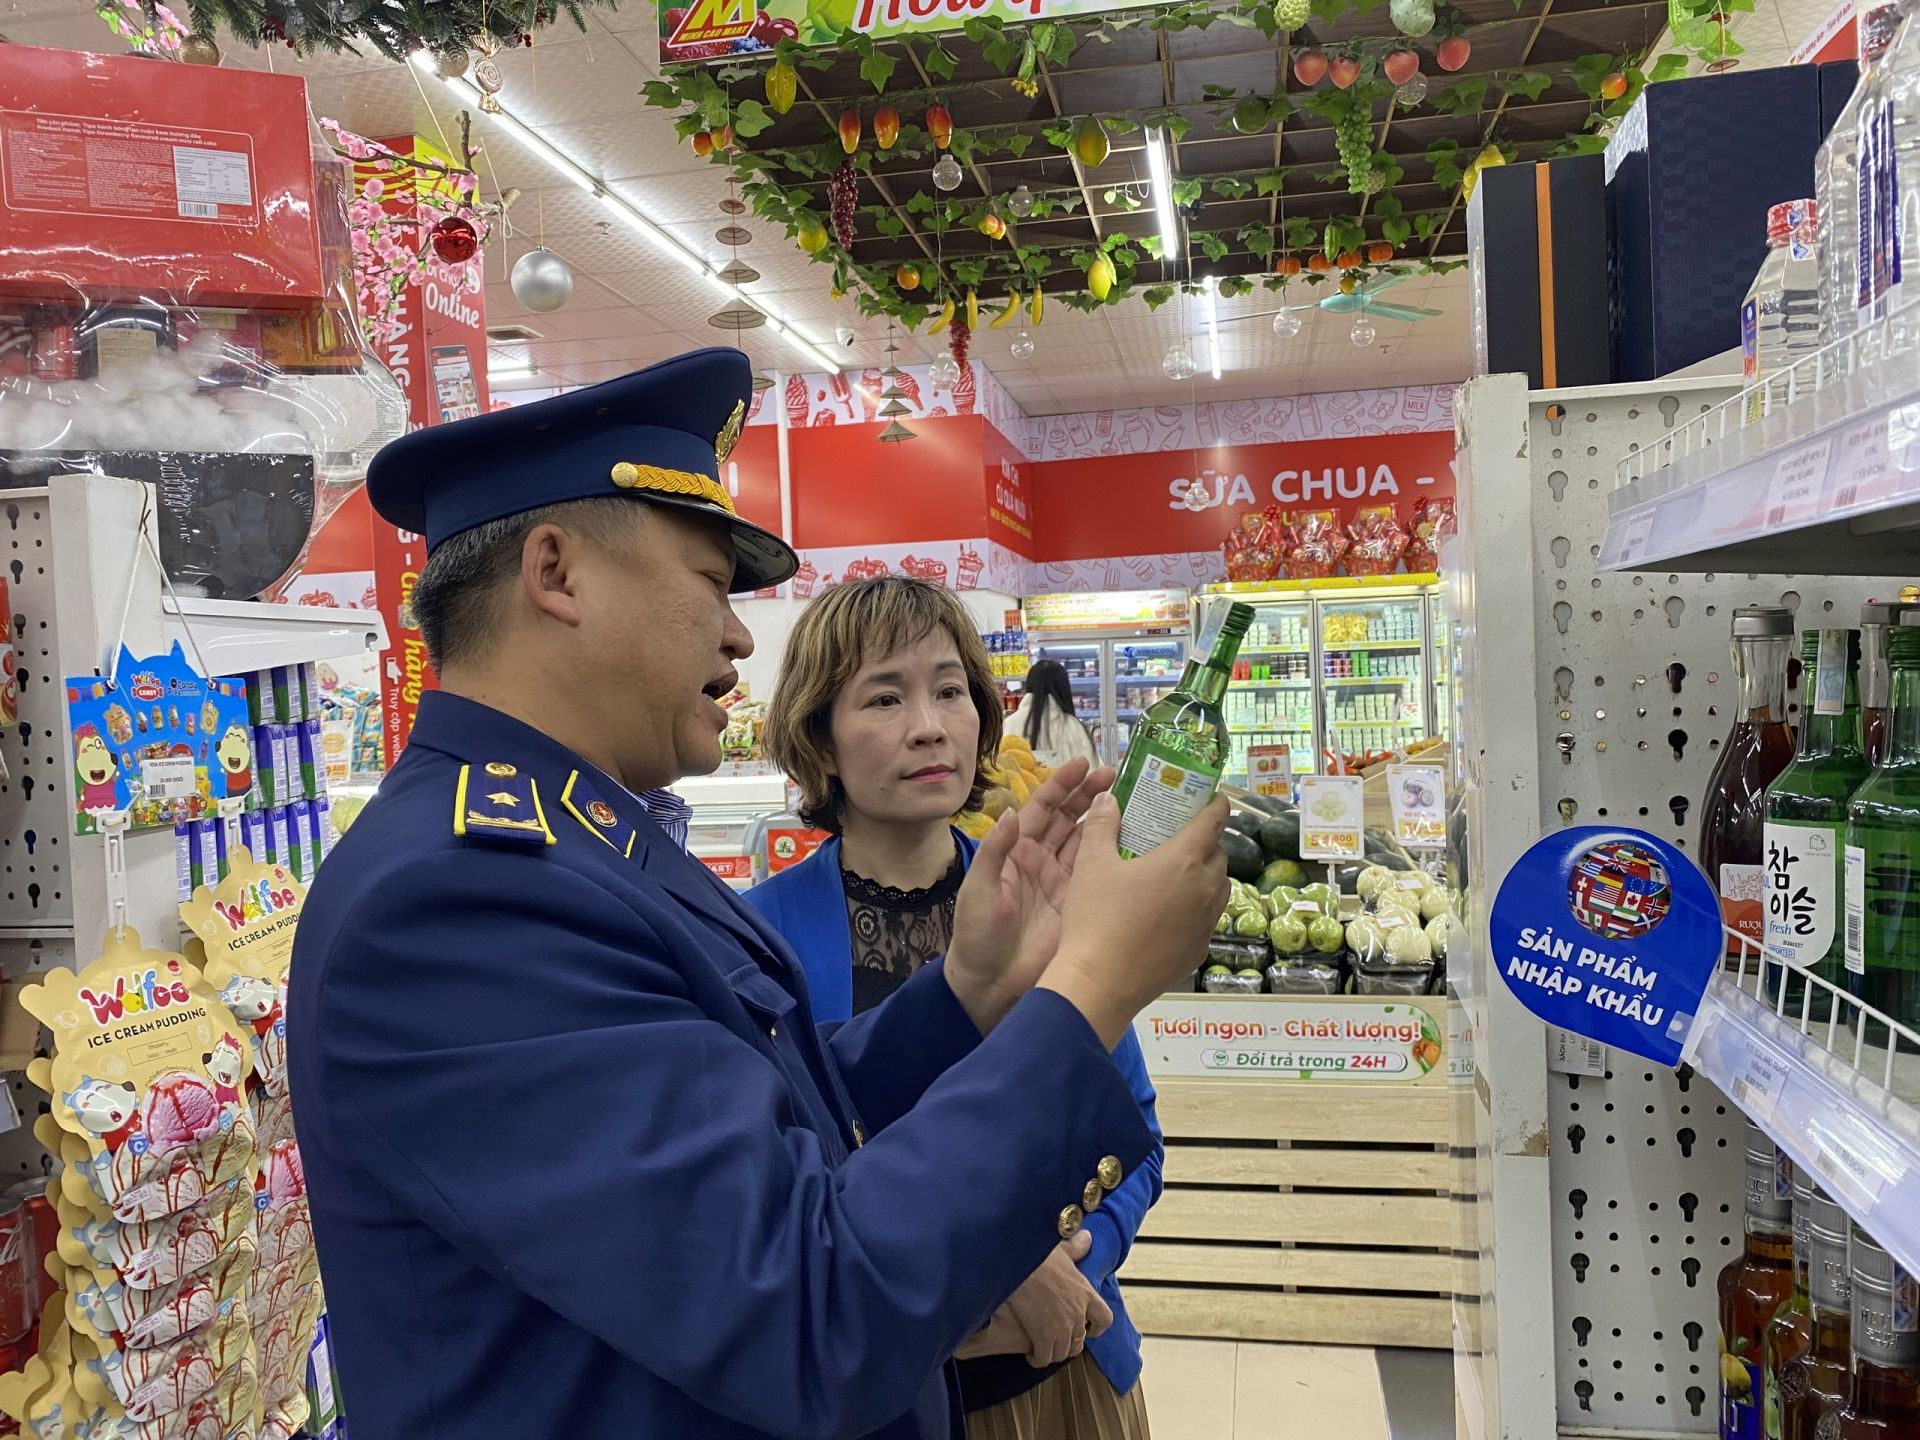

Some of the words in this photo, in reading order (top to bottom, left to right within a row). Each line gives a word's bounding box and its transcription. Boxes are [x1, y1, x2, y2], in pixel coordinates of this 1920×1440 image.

[679, 30, 704, 41] MINH
[721, 25, 750, 36] MART
[425, 282, 480, 329] Online
[1407, 400, 1425, 411] MILK
[1271, 464, 1399, 502] CHUA
[1136, 647, 1176, 655] VINACOOL
[131, 671, 161, 686] Wolfoo
[138, 689, 157, 697] CANDY
[388, 687, 399, 712] Truy
[1768, 840, 1817, 935] 참이슬
[228, 936, 246, 951] ICE
[244, 925, 277, 944] CREAM
[1769, 920, 1792, 936] fresh
[1517, 926, 1574, 962] SẢN
[1576, 955, 1657, 991] PHẨM
[80, 971, 190, 1024] Wolfoo
[1507, 957, 1582, 996] NHẬP
[1586, 993, 1664, 1026] KHẨU
[87, 1033, 112, 1048] ICE
[115, 1022, 154, 1040] CREAM
[156, 1007, 206, 1029] PUDDING
[1150, 1017, 1198, 1036] Tươi
[1204, 1020, 1263, 1040] ngon
[1284, 1018, 1339, 1038] Chất
[1346, 1019, 1421, 1042] lượng!
[1236, 1051, 1265, 1066] Đổi
[1270, 1051, 1293, 1067] trả
[1298, 1054, 1345, 1070] trong
[1350, 1055, 1387, 1069] 24H
[133, 1140, 144, 1151] C
[258, 1198, 267, 1208] C
